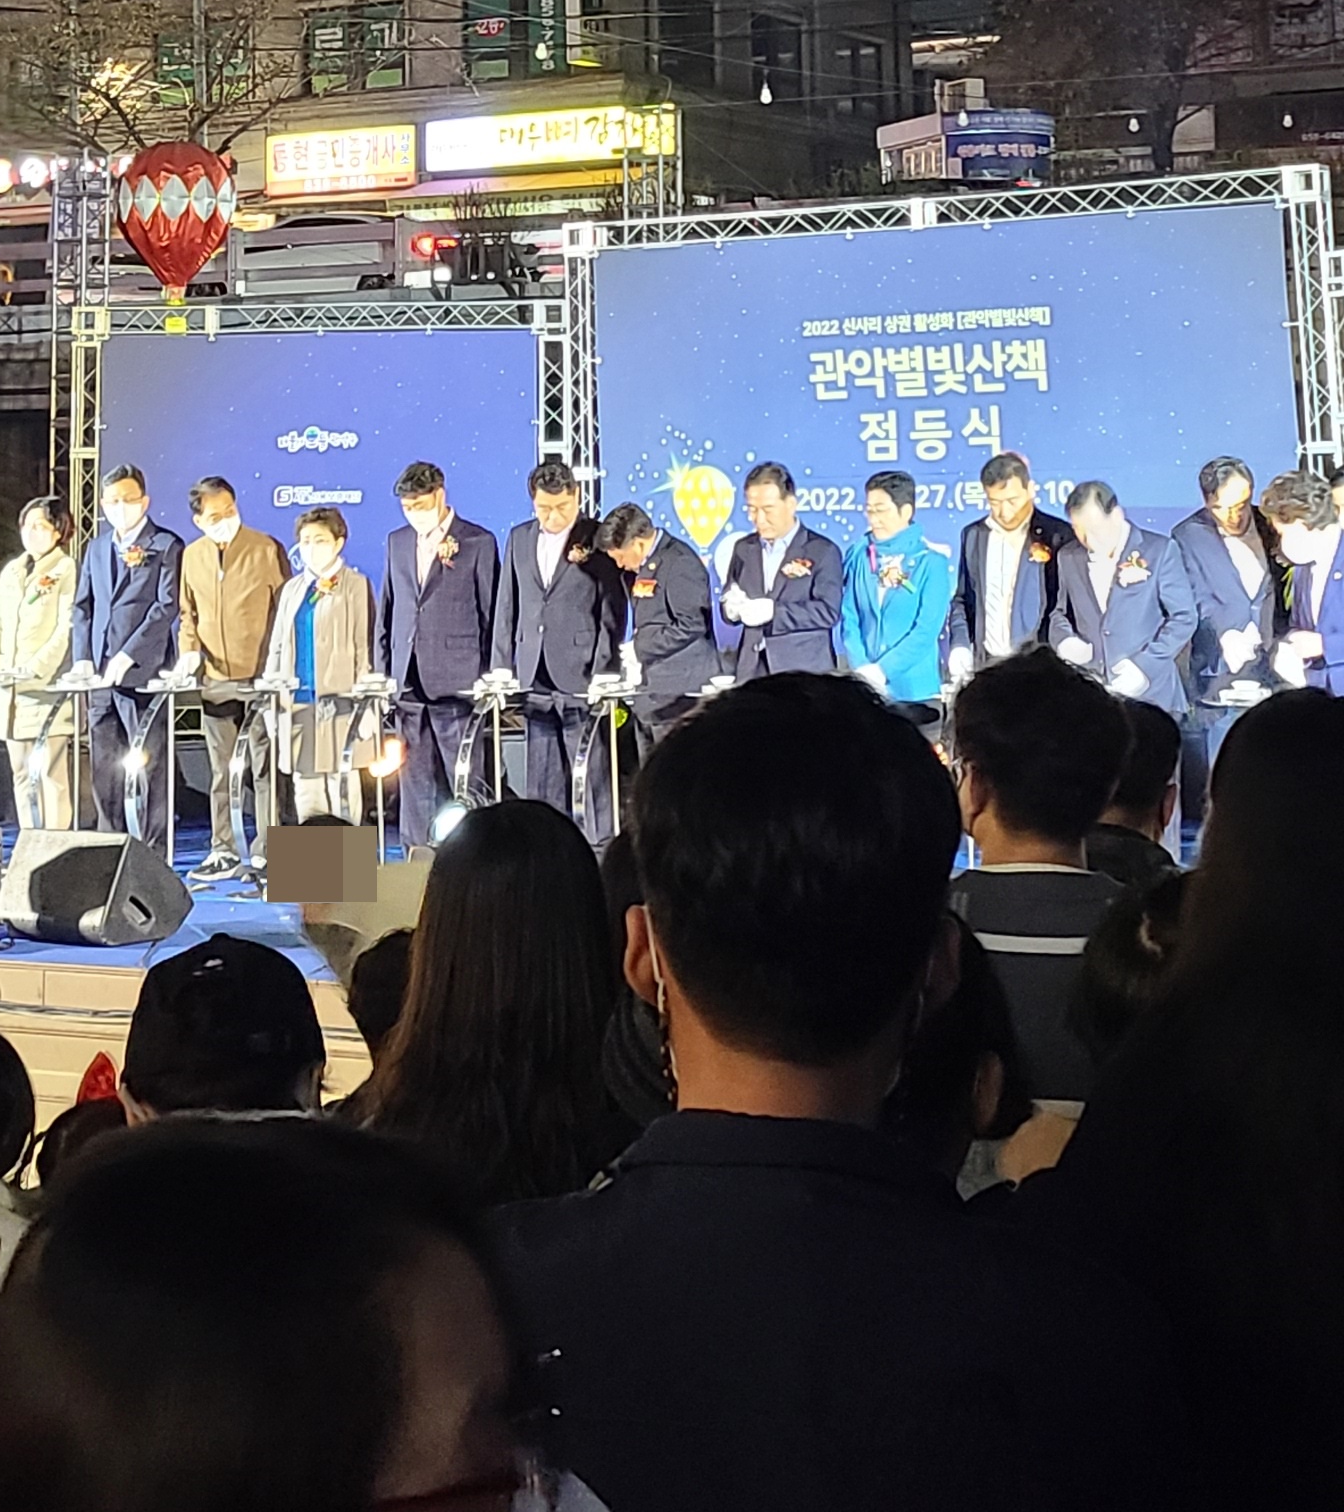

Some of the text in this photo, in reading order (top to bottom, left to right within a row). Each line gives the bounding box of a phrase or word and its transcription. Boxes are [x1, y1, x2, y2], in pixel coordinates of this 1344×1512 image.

[802, 306, 1052, 337] 2022 신사리 상권 활성화 [관악별빛산책]
[809, 338, 1050, 401] 관악별빛산책
